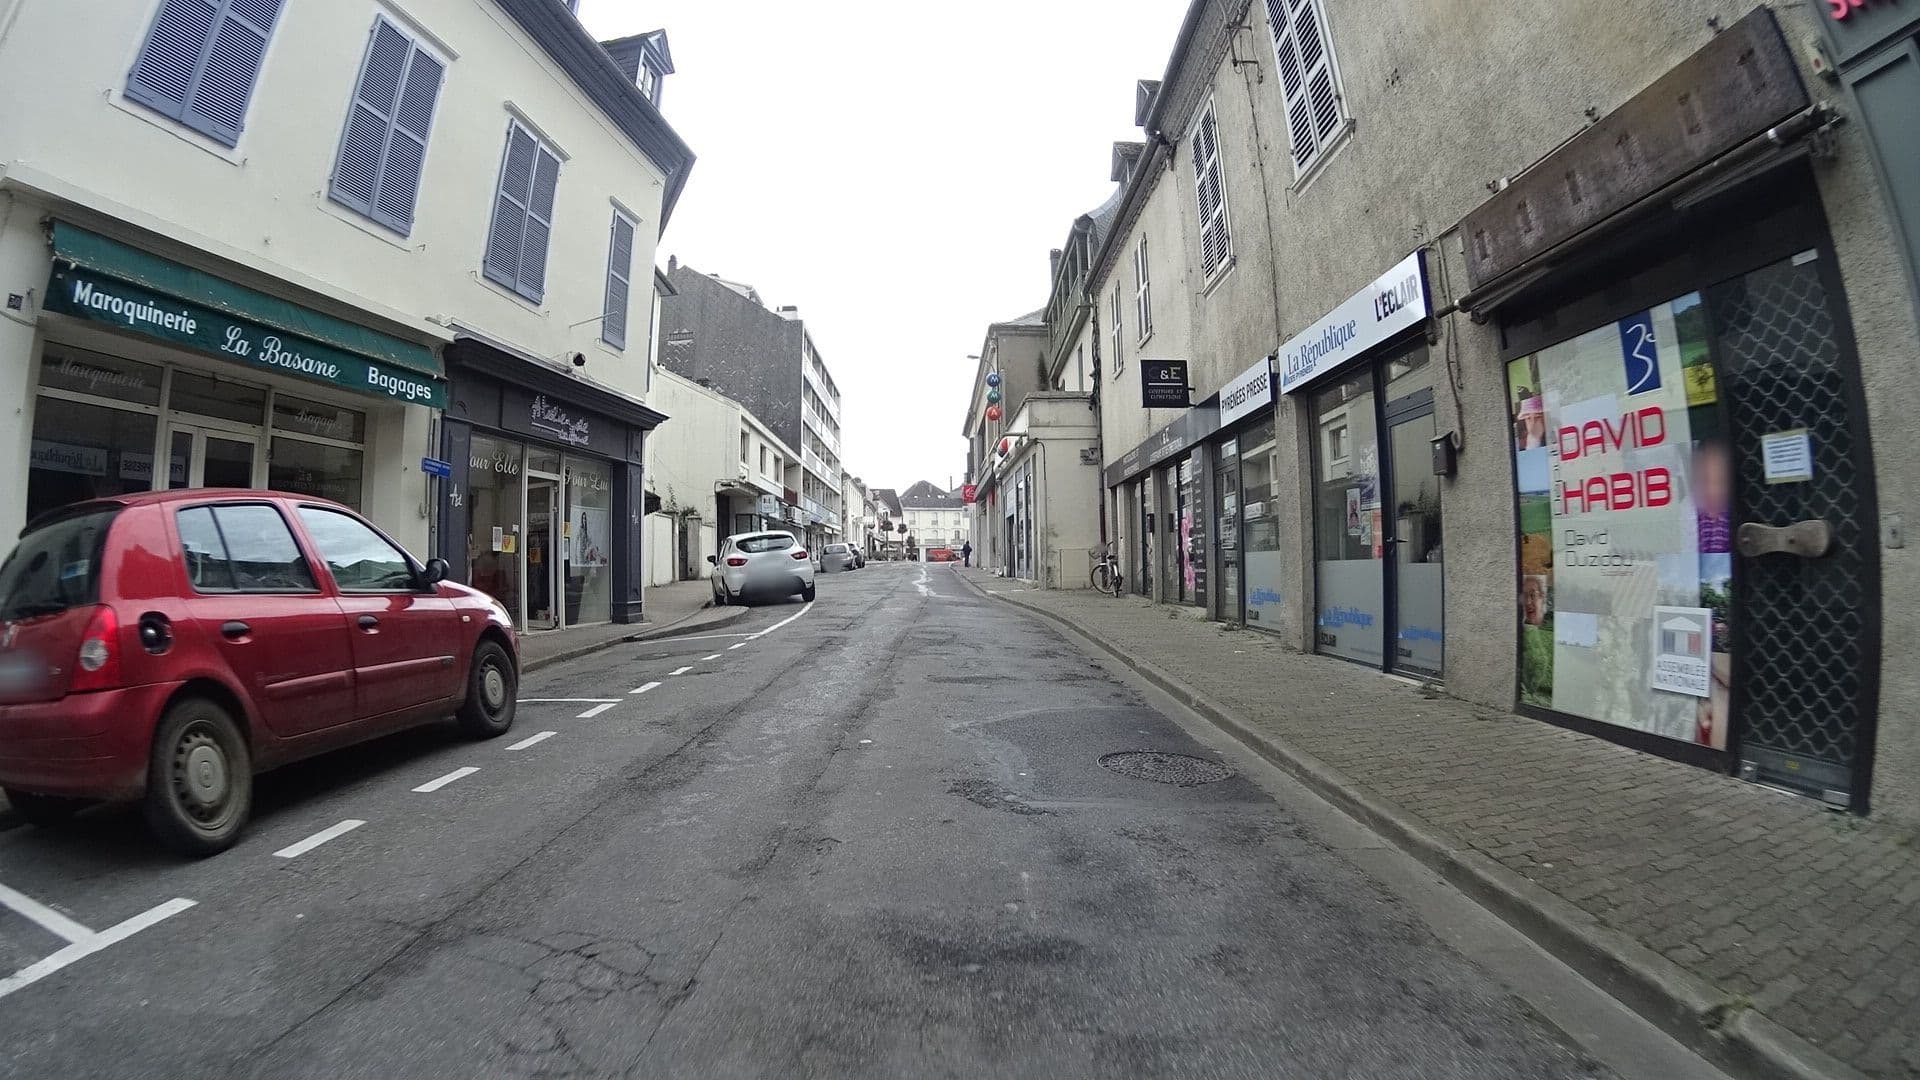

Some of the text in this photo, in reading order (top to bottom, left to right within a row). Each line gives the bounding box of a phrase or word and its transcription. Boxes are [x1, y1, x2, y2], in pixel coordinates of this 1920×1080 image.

[73, 279, 197, 334] Maroquinerie
[220, 325, 341, 378] La Basane
[1288, 319, 1356, 375] La République
[368, 366, 432, 400] Bagages
[1246, 372, 1268, 400] PRESSE
[1558, 406, 1665, 461] DAVID
[493, 450, 520, 475] Elle
[1561, 467, 1671, 515] HABIB
[1565, 529, 1608, 546] David
[1656, 673, 1706, 691] NATIONALE
